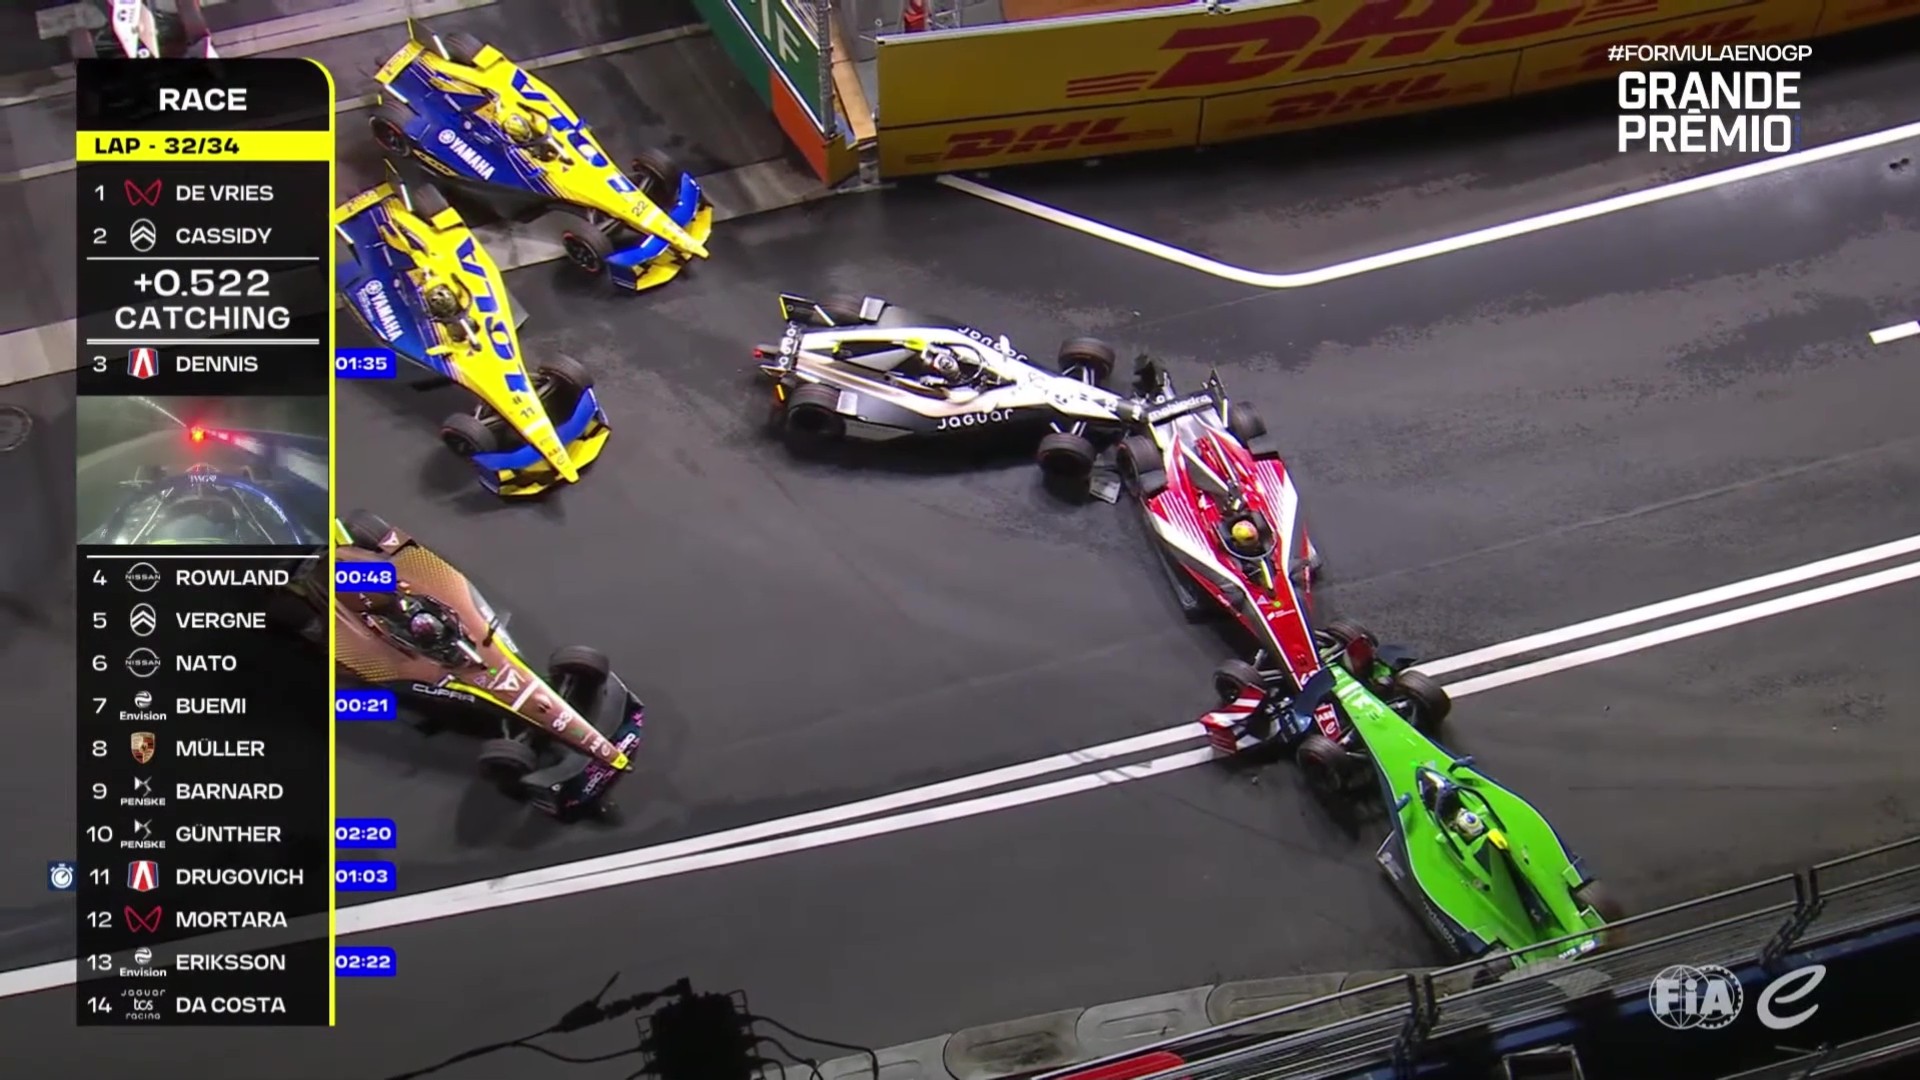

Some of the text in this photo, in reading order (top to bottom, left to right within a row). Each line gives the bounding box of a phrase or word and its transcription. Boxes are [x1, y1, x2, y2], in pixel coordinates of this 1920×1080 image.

[751, 0, 800, 63] IF
[1149, 0, 1584, 89] DHL
[1266, 73, 1451, 124] DHL
[449, 137, 495, 180] YAMAHA
[944, 117, 1130, 160] DHL
[370, 291, 404, 342] YAMAHA
